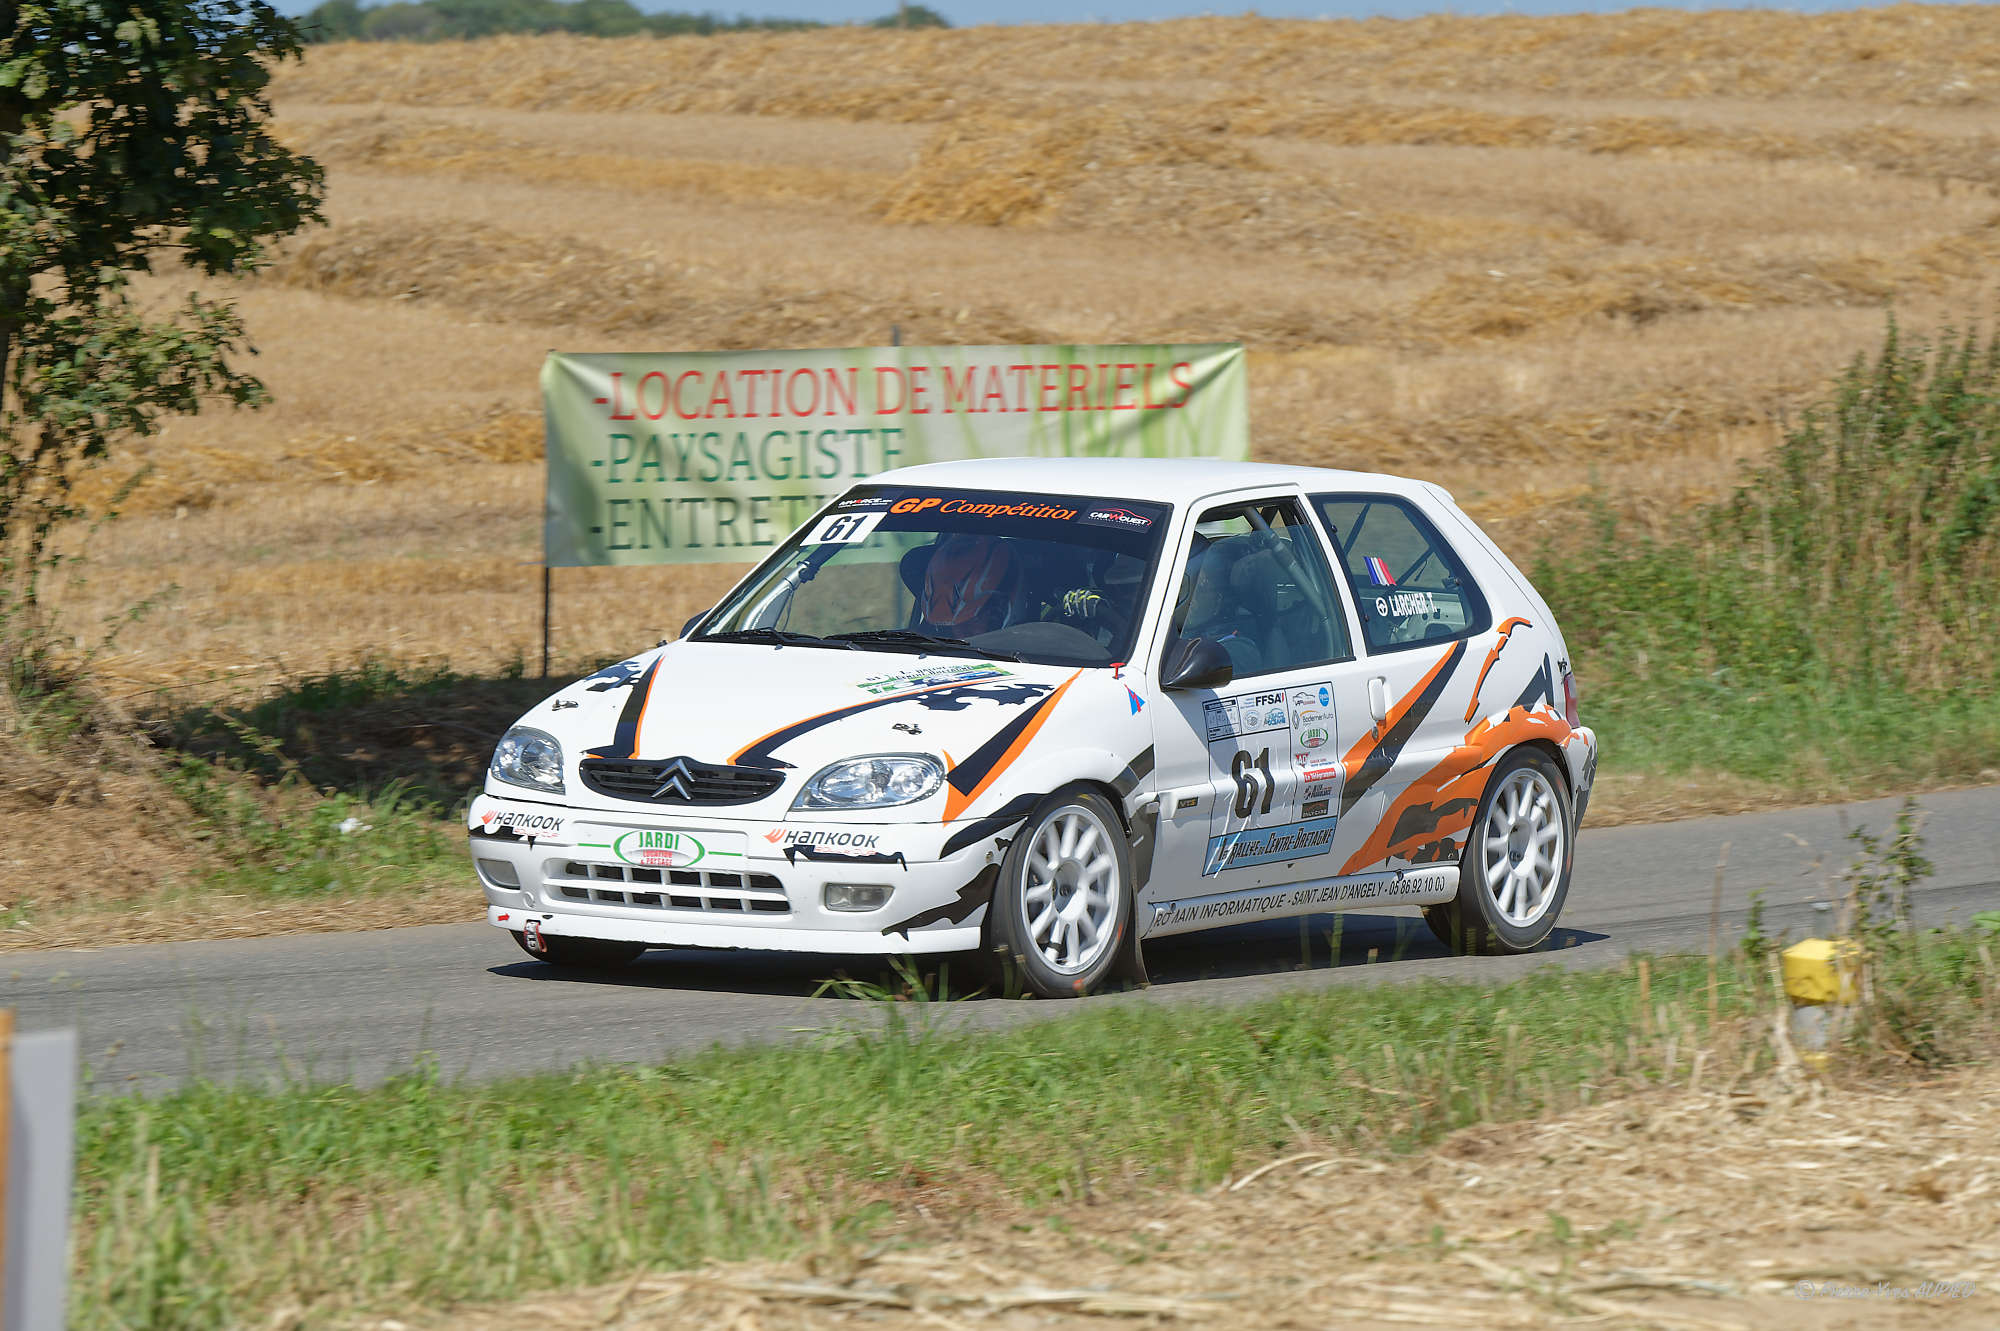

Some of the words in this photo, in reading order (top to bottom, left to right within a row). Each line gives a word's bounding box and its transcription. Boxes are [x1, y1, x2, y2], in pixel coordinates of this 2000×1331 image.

[873, 365, 930, 415] DE
[941, 361, 1196, 414] MATERIELS
[889, 497, 943, 514] GP
[820, 514, 868, 541] 61
[1388, 592, 1429, 617] LARCHER
[1255, 692, 1282, 706] FFSA
[1231, 747, 1276, 819] 61
[638, 831, 680, 850] JARDI
[1199, 893, 1287, 919] INFORMATIQUE
[1291, 888, 1319, 906] SAINT
[1316, 886, 1340, 903] JEAN
[1339, 881, 1385, 900] D'ANGELY
[1388, 880, 1399, 896] 05
[1400, 880, 1411, 895] 86
[1412, 878, 1422, 893] 92
[1424, 877, 1433, 893] 10
